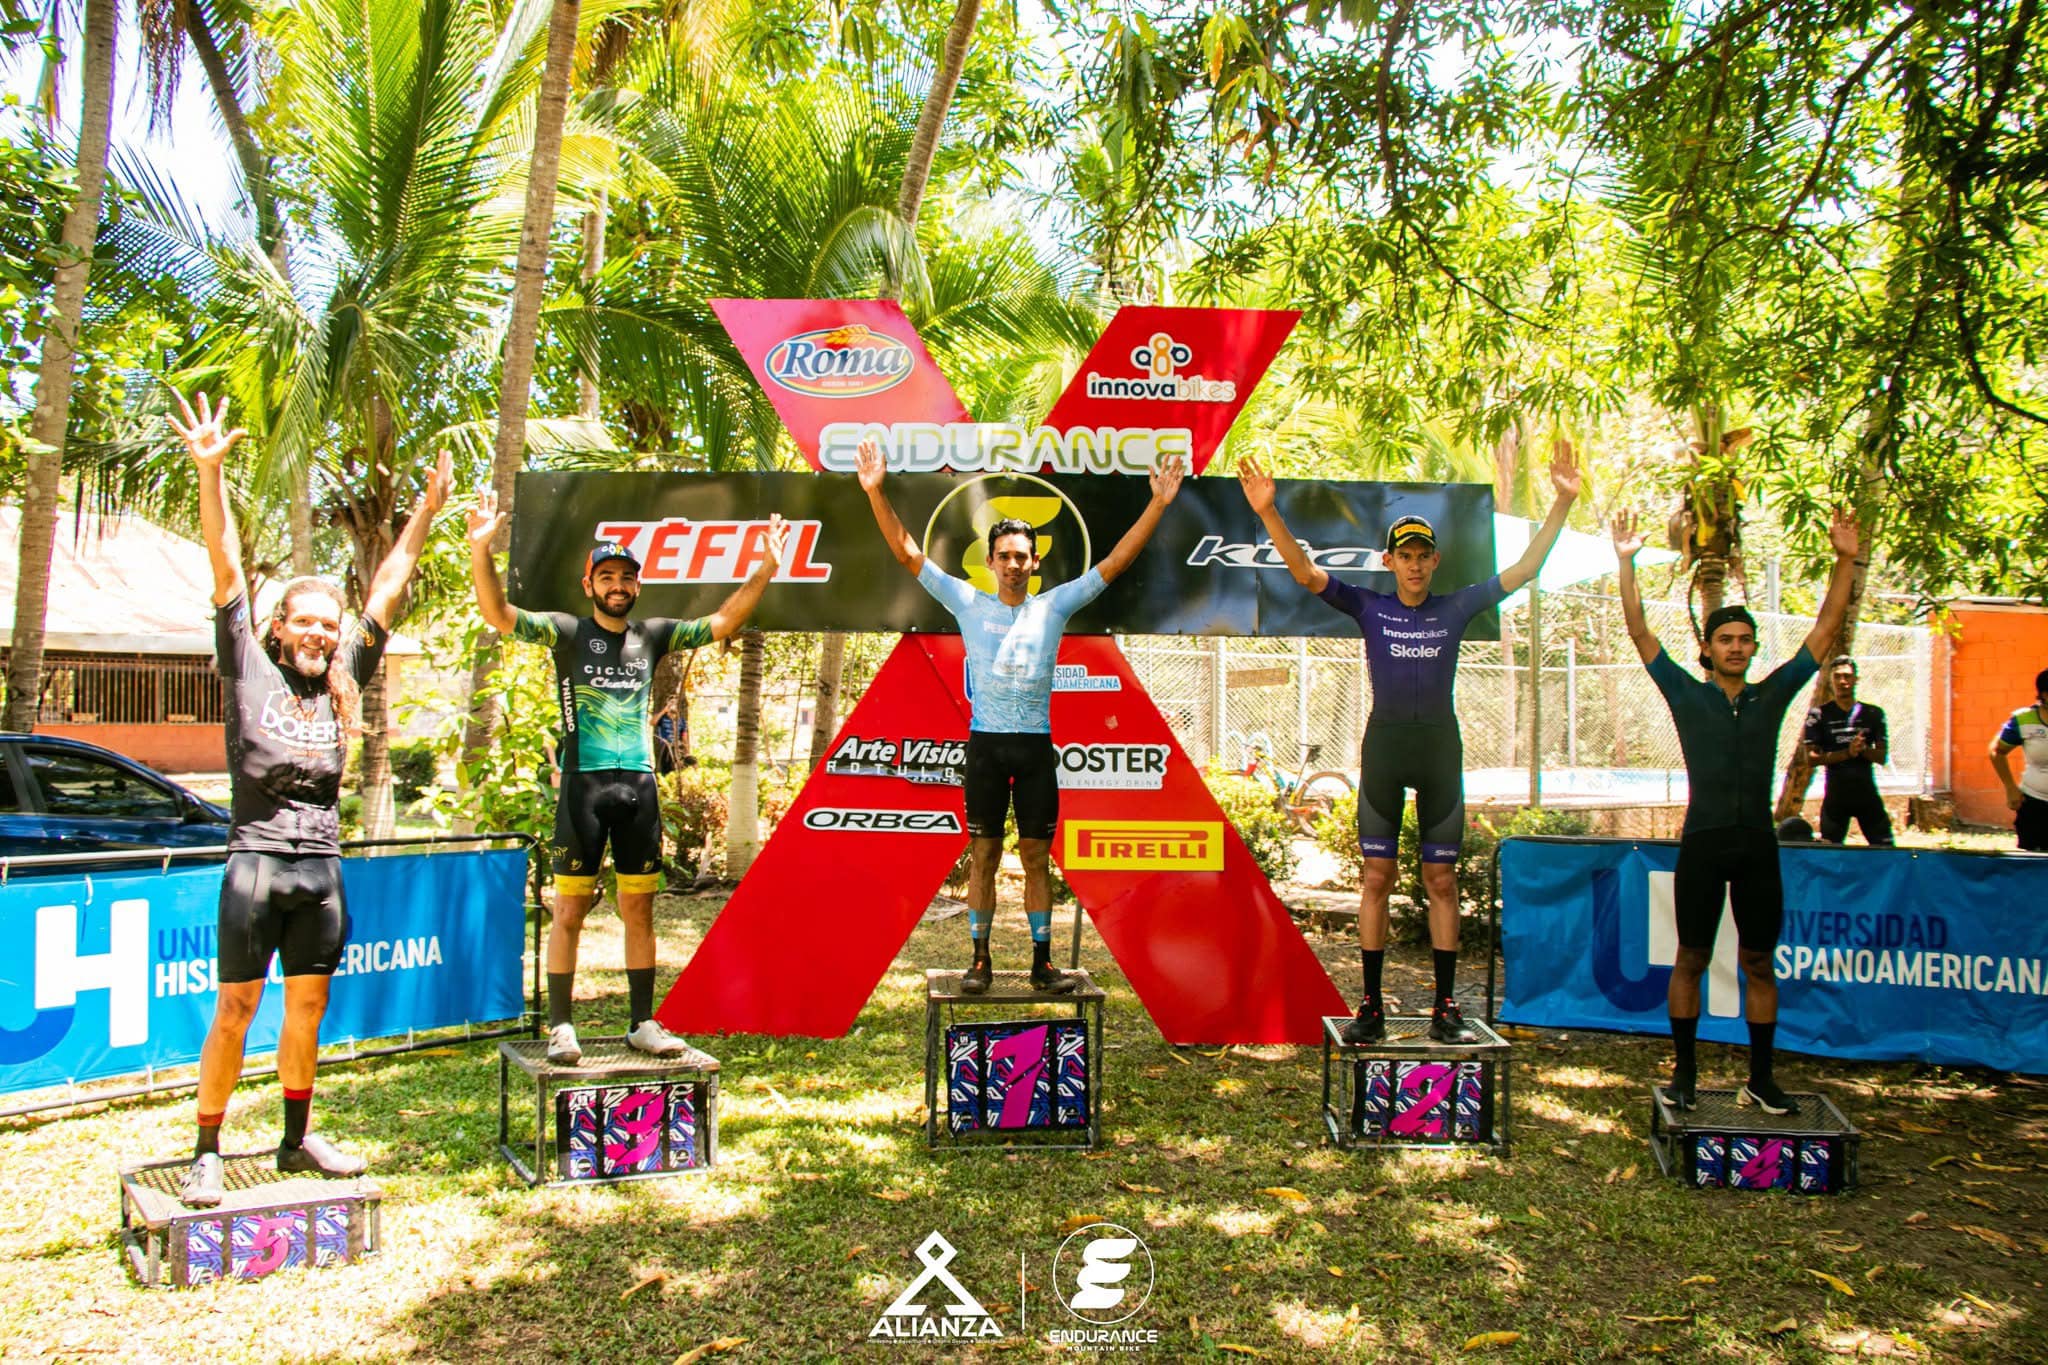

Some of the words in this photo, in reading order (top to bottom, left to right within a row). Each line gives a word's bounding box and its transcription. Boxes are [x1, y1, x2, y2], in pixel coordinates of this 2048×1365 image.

[777, 341, 903, 379] Roma
[1090, 375, 1234, 399] innovabikes
[823, 427, 1191, 472] ENDURANCE
[1383, 626, 1448, 639] innovabikes
[1390, 644, 1441, 658] Skoler
[561, 676, 576, 733] OROTINA
[834, 737, 896, 761] Arte
[902, 740, 966, 765] Visió
[806, 811, 959, 830] ORBEA
[1077, 829, 1208, 858] PIRELLI
[992, 1025, 1053, 1128] 1
[1389, 1064, 1462, 1135] 2
[242, 1217, 295, 1277] 5
